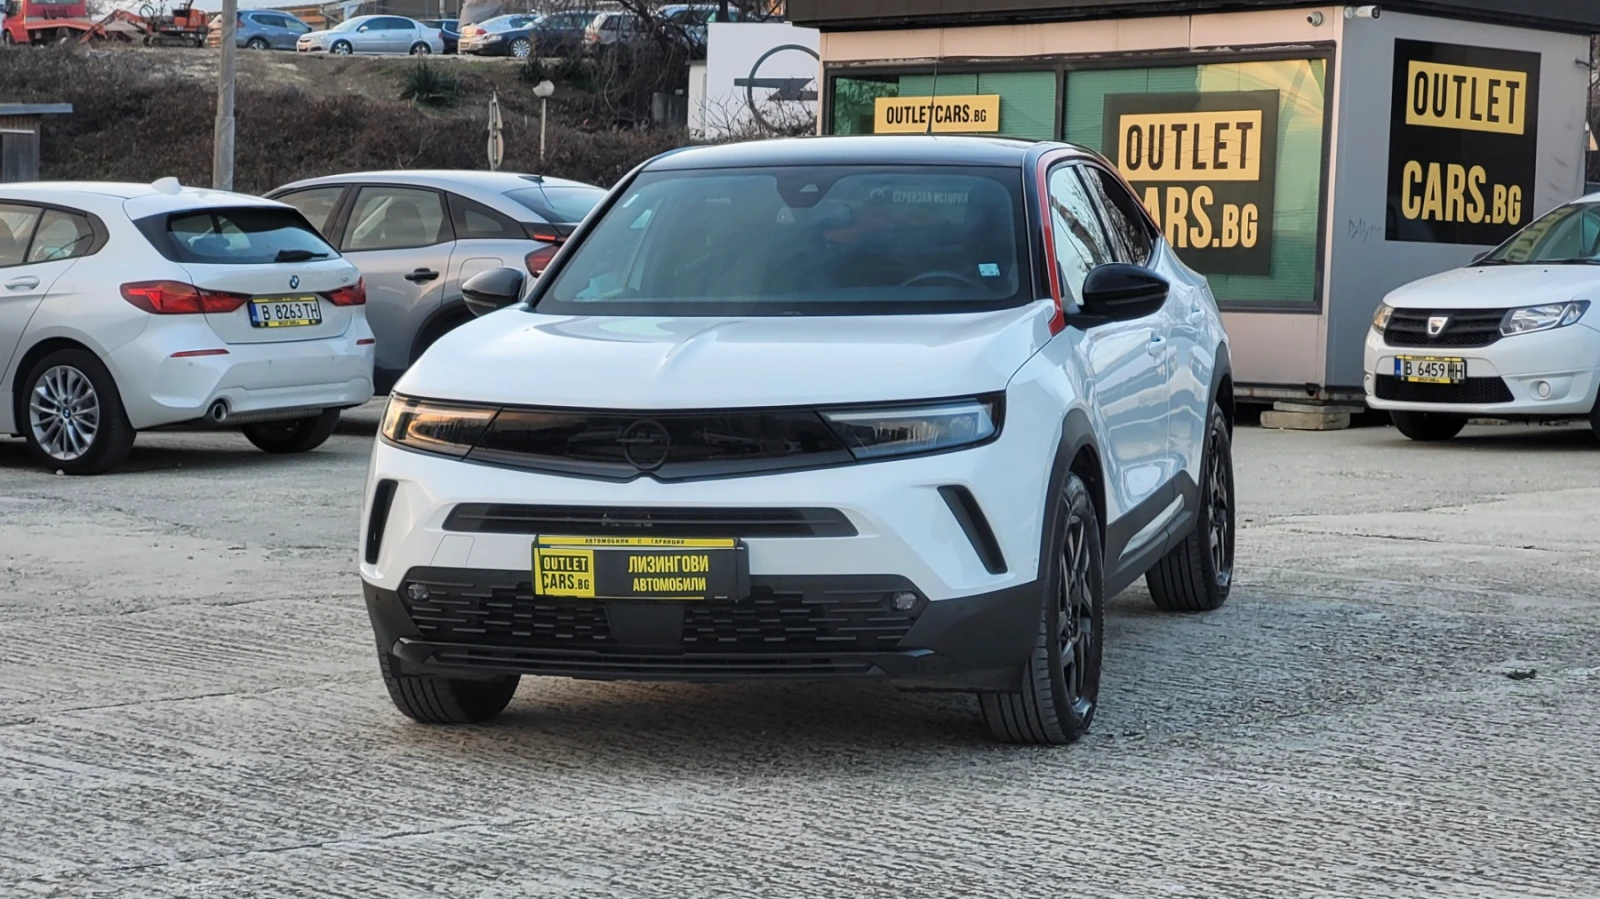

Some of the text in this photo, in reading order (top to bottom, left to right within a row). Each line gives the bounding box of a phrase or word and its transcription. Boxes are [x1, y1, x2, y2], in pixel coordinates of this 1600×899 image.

[1413, 70, 1520, 124] OUTLET
[1125, 121, 1253, 171] OUTLET
[1401, 160, 1522, 225] CARS.BG
[1142, 185, 1258, 249] ARS.BG
[543, 557, 587, 571] OUTLET
[628, 554, 709, 573] ЛИЗИНГОВИ
[541, 573, 590, 590] CARS.BG
[632, 577, 707, 592] АВТОМОБИЛИ
